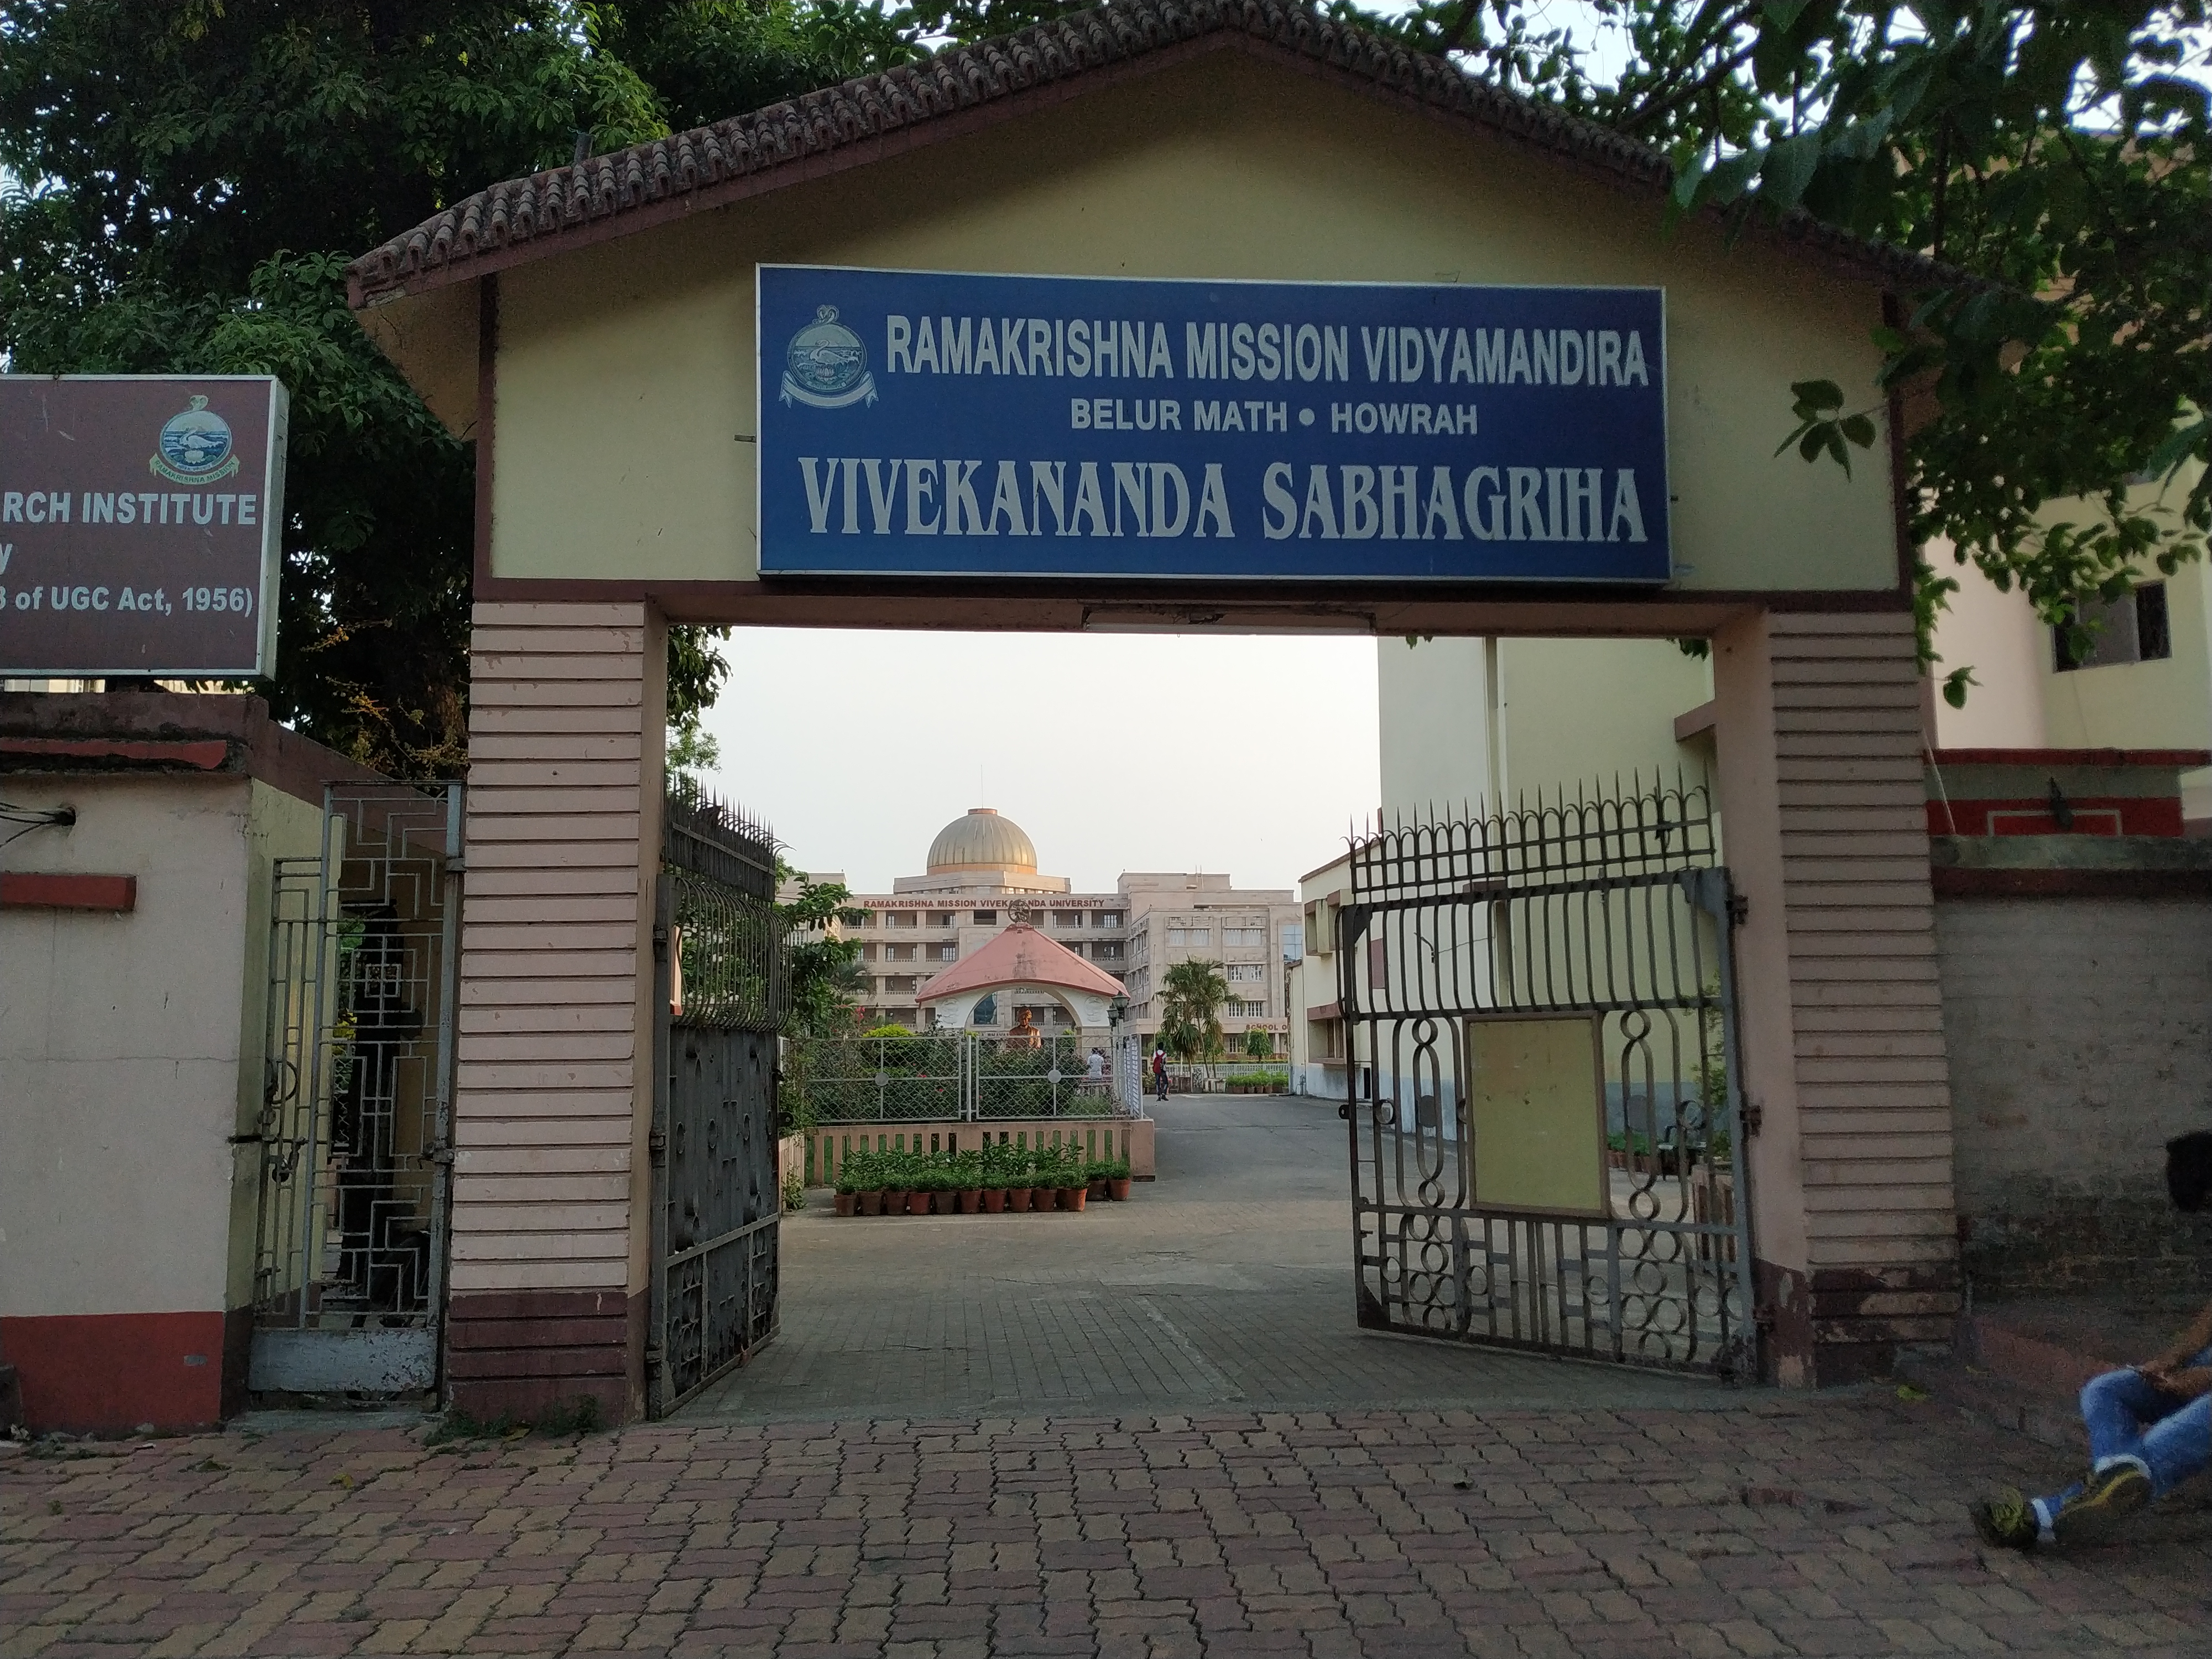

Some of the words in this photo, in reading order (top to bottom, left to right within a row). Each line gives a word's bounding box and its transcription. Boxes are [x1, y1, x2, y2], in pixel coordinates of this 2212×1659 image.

[886, 314, 1175, 379] RAMAKRISHNA
[1186, 321, 1349, 382] MISSION
[1360, 325, 1650, 388] VIDYAMANDIRA
[1071, 398, 1182, 431] BELUR
[1193, 400, 1288, 432] MATH
[1331, 401, 1478, 435] HOWRAH
[155, 460, 205, 483] RAMAKRISHNA
[207, 461, 235, 482] MISSION
[81, 492, 257, 525] INSTITUTE
[797, 456, 1236, 538] VIVEKANANDA
[1262, 461, 1648, 542] SABHAGRIHA
[14, 586, 44, 611] of
[50, 586, 110, 611] UGC
[117, 586, 173, 617] Act,
[181, 586, 253, 618] 1956)
[863, 900, 934, 908] RAMAKRISHNA
[1049, 899, 1105, 907] UNIVERSITY
